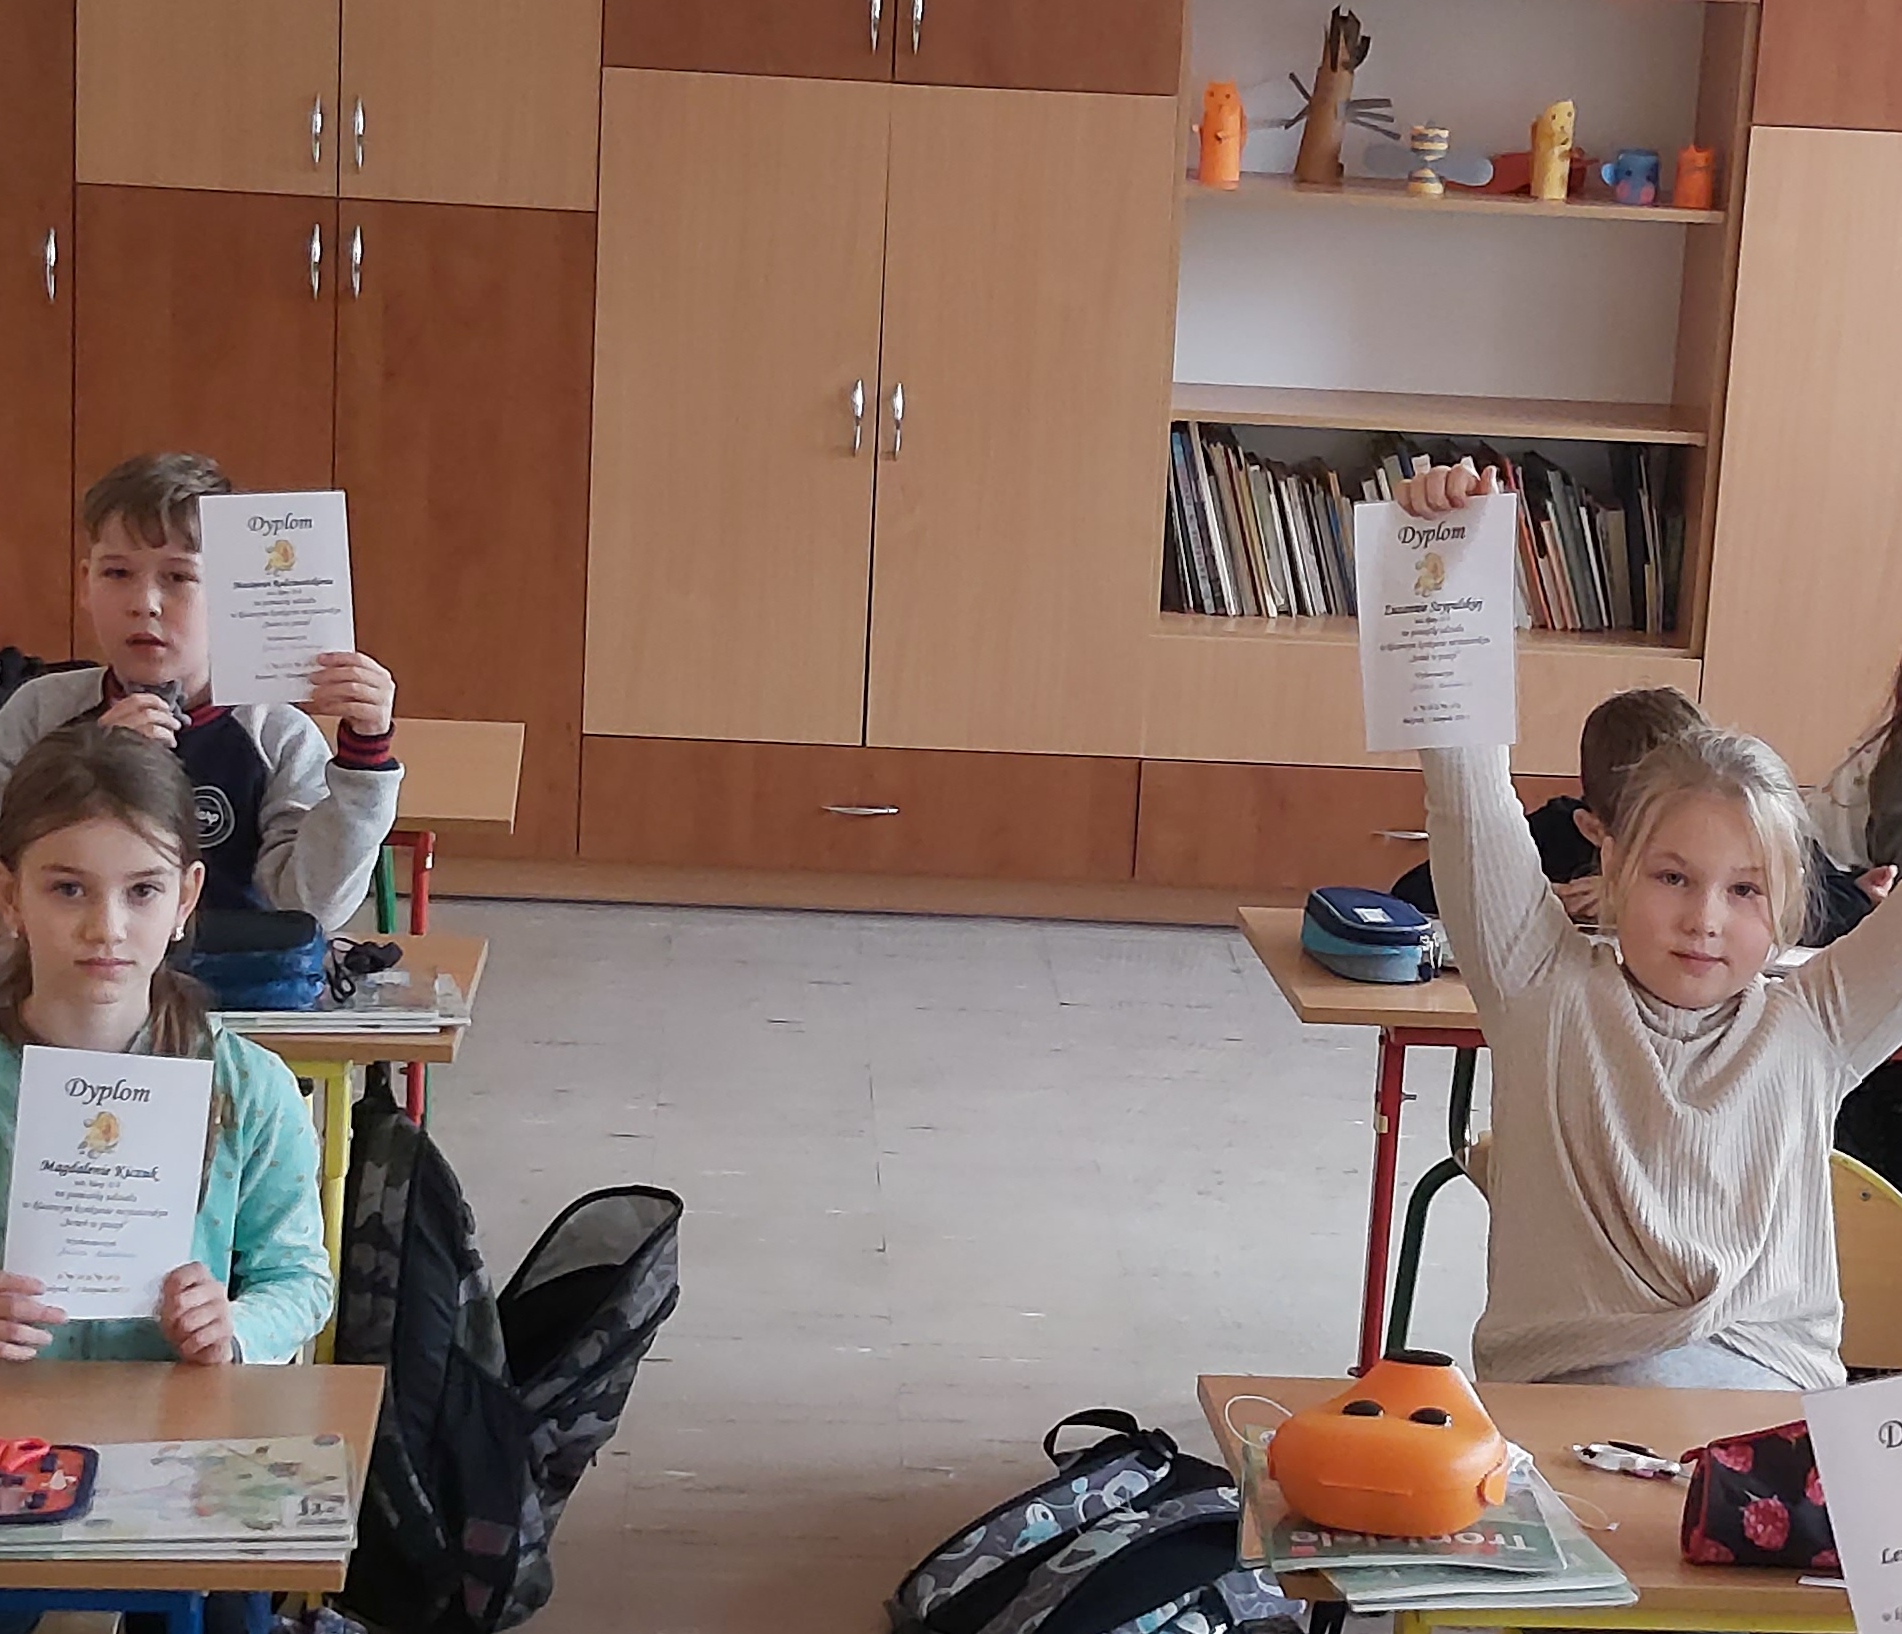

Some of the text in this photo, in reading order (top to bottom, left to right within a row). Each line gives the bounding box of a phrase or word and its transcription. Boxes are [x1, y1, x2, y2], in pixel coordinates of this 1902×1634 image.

[248, 512, 313, 537] Dyplom
[1398, 521, 1466, 550] Dyplom
[64, 1076, 151, 1106] Dyplom
